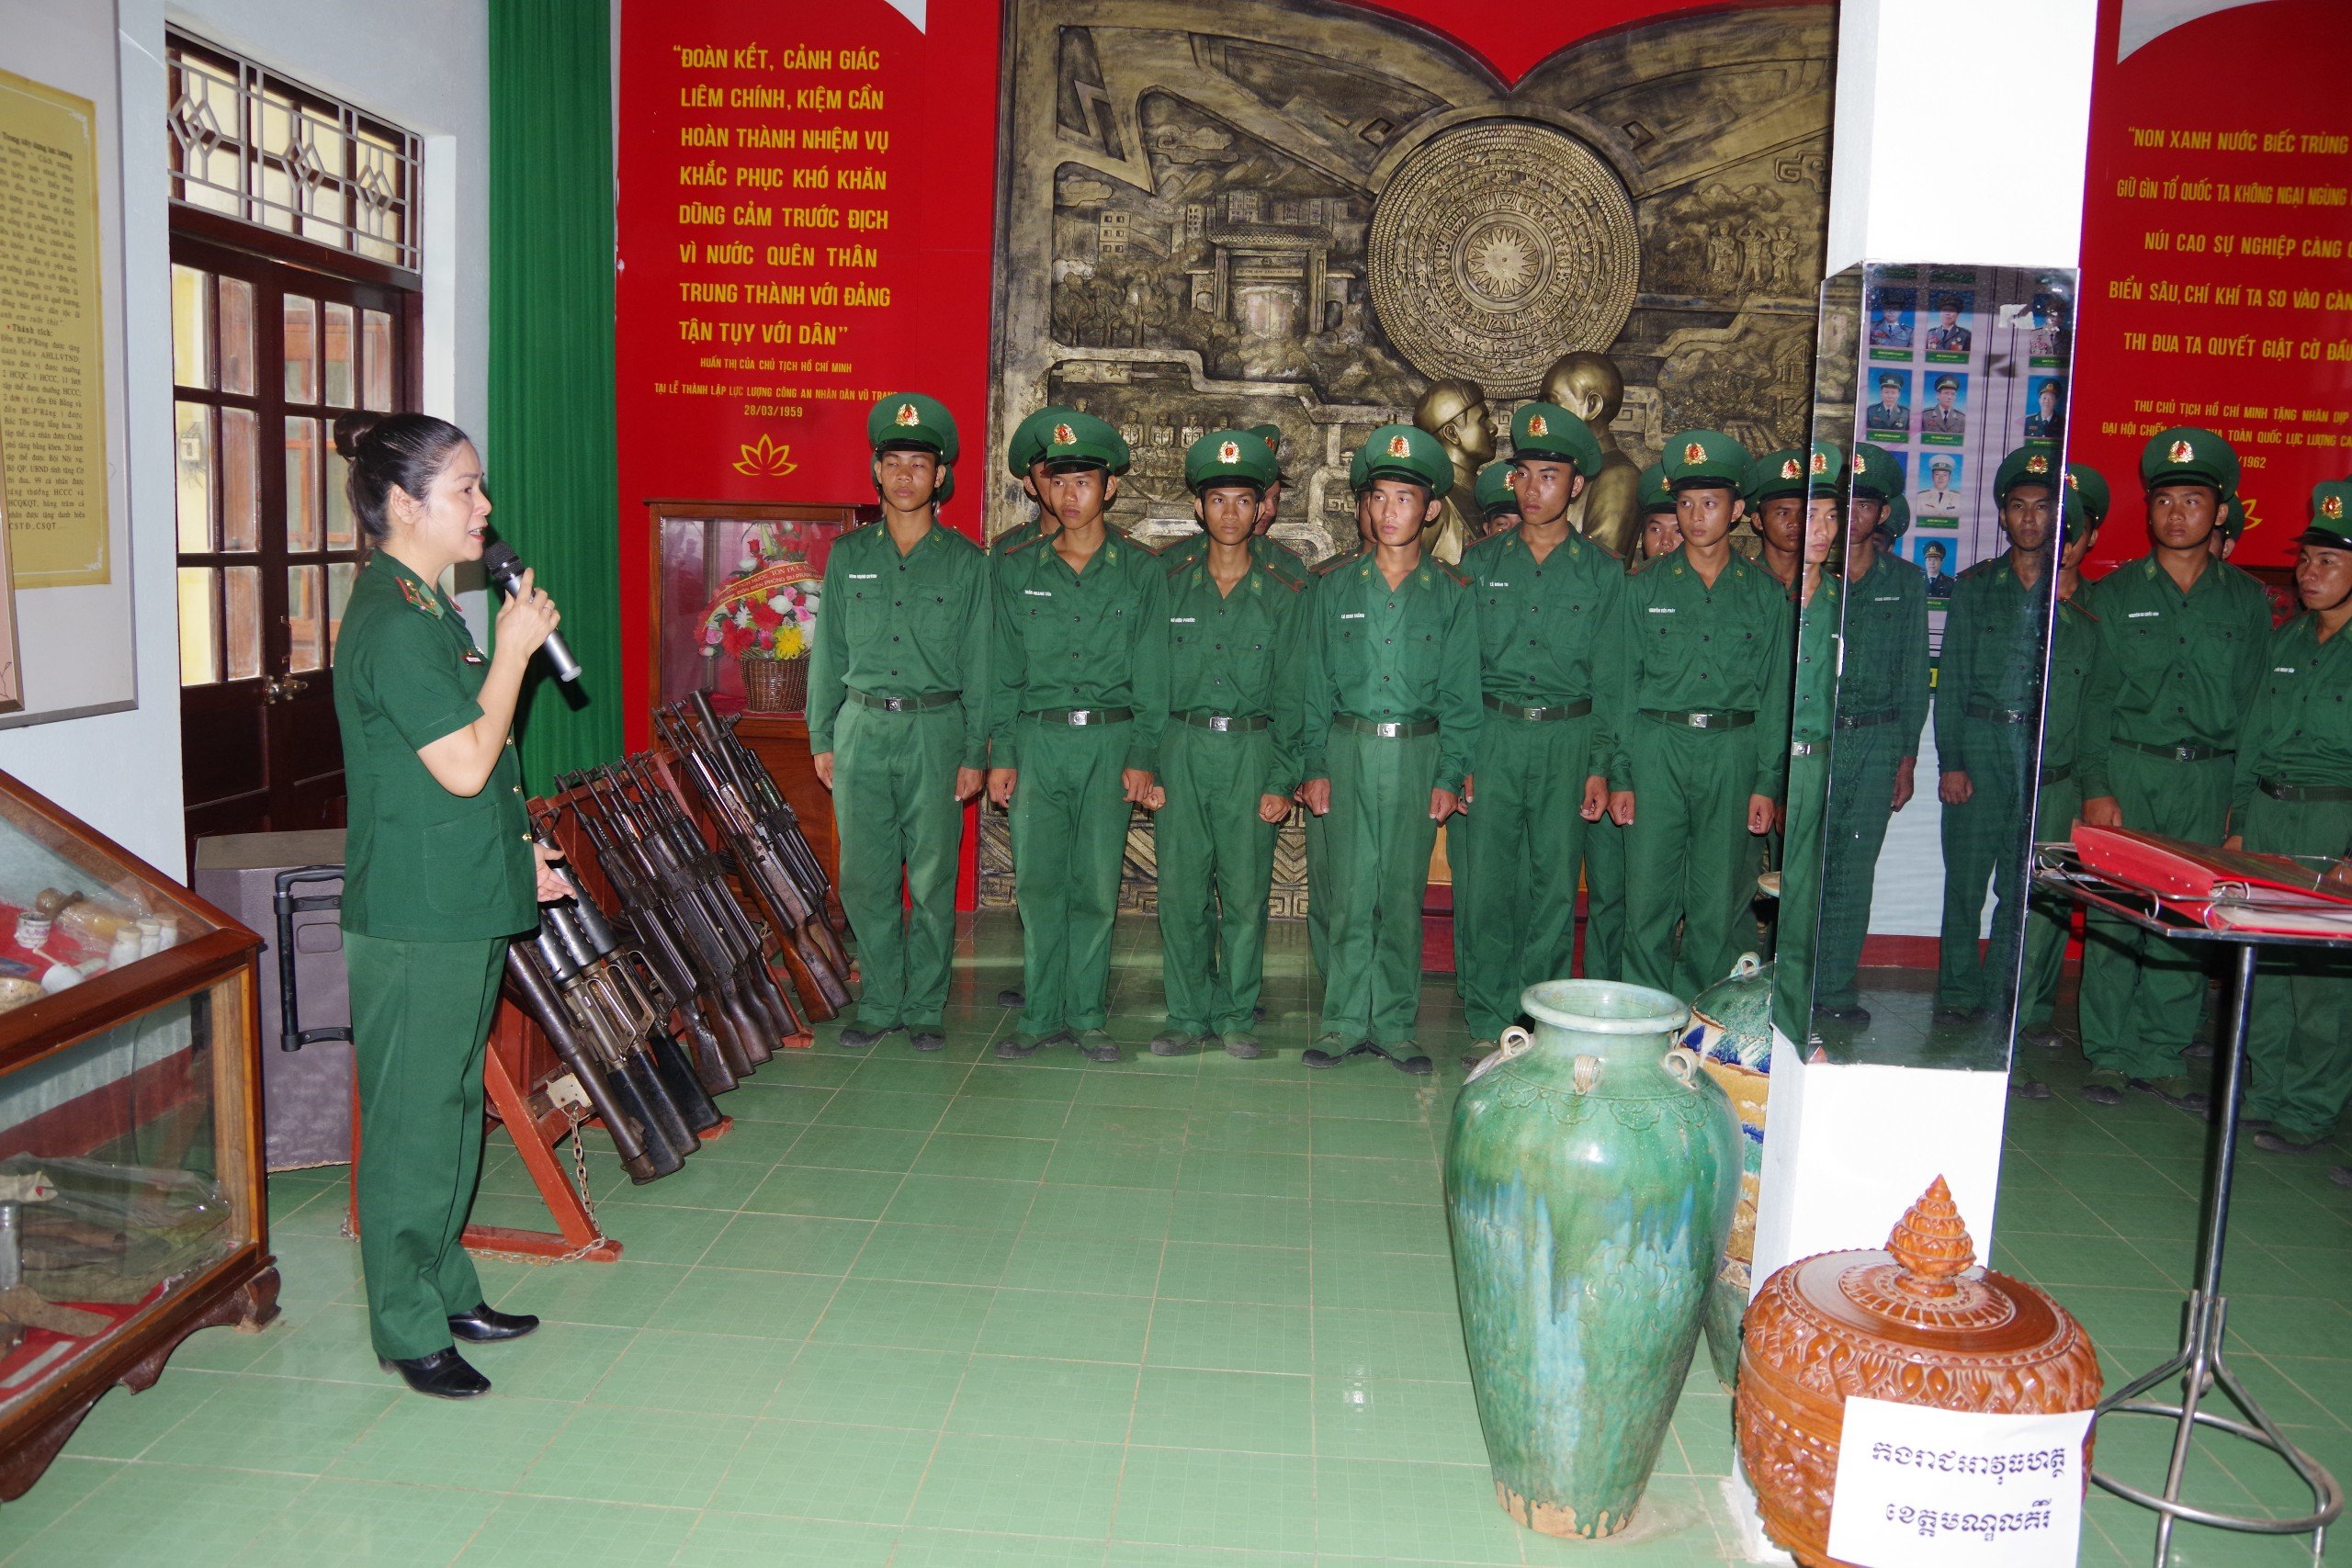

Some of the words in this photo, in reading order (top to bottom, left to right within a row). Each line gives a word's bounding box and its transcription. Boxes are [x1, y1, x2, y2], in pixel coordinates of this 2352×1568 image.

[673, 44, 729, 69] “ĐOÀN
[733, 41, 775, 72] KẾT,
[783, 43, 832, 71] CẢNH
[839, 45, 880, 72] GIÁC
[680, 84, 724, 107] LIÊM
[729, 84, 792, 111] CHÍNH,
[797, 85, 842, 113] KIỆM
[847, 83, 885, 110] CẦN
[681, 123, 729, 148] HOÀN
[736, 124, 796, 149] THÀNH
[801, 125, 859, 153] NHIỆM
[864, 130, 889, 154] VỤ
[2129, 126, 2165, 148] “NON
[2169, 130, 2212, 150] XANH
[2217, 130, 2258, 152] NƯỚC
[2263, 129, 2296, 153] BIẾC
[2301, 131, 2349, 154] TRÙNG
[679, 159, 728, 186] KHẮC
[736, 166, 784, 191] PHỤC
[792, 164, 830, 189] KHÓ
[836, 165, 887, 191] KHĂN
[2117, 175, 2137, 197] GIỮ
[2139, 176, 2158, 199] GÌN
[2163, 175, 2180, 200] TỔ
[2180, 177, 2212, 201] QUỐC
[2217, 184, 2231, 202] TA
[2233, 182, 2273, 204] KHÔNG
[2277, 186, 2304, 209] NGẠI
[2307, 184, 2347, 206] NGÙNG
[679, 201, 726, 226] DŨNG
[732, 199, 773, 227] CẢM
[781, 203, 840, 229] TRƯỚC
[847, 209, 889, 233] ĐỊCH
[679, 240, 697, 264] VÌ
[706, 240, 754, 265] NƯỚC
[765, 243, 816, 267] QUÊN
[826, 243, 877, 268] THÂN
[2144, 229, 2170, 251] NÚI
[2176, 233, 2206, 253] CAO
[2213, 234, 2234, 257] SỰ
[2240, 234, 2297, 259] NGHIỆP
[2301, 236, 2343, 258] CÀNG
[679, 282, 739, 304] TRUNG
[744, 281, 805, 306] THÀNH
[809, 281, 839, 307] VỚI
[842, 280, 891, 308] ĐẢNG
[2109, 275, 2143, 300] BIỂN
[2149, 280, 2180, 305] SÂU,
[2184, 283, 2211, 304] CHÍ
[2214, 285, 2243, 306] KHÍ
[2246, 288, 2263, 307] TA
[2267, 289, 2288, 308] SO
[2292, 288, 2321, 310] VÀO
[678, 317, 713, 344] TẬN
[718, 322, 756, 346] TỤY
[761, 320, 792, 344] VỚI
[797, 321, 849, 346] DÂN”
[2123, 332, 2147, 351] THI
[2151, 333, 2179, 353] ĐUA
[2185, 335, 2202, 354] TA
[2208, 333, 2256, 357] QUYẾT
[2261, 337, 2294, 361] GIẬT
[2300, 338, 2322, 360] CỜ
[700, 355, 722, 368] HUẤN
[723, 358, 738, 371] THỊ
[739, 356, 755, 370] CỦA
[758, 358, 775, 371] CHỦ
[778, 360, 798, 373] TỊCH
[800, 358, 813, 372] HỒ
[814, 360, 829, 373] CHÍ
[831, 362, 853, 374] MINH
[872, 390, 898, 401] TRA
[743, 404, 803, 418] 28/03/1959
[2134, 400, 2154, 412] THƯ
[2155, 399, 2176, 414] CHỦ
[2180, 402, 2201, 418] TỊCH
[2205, 401, 2220, 417] HỒ
[2222, 404, 2240, 418] CHÍ
[2243, 406, 2268, 420] MINH
[2273, 406, 2298, 423] TẶNG
[2302, 408, 2329, 423] NHÂN
[2333, 411, 2349, 425] DỊP
